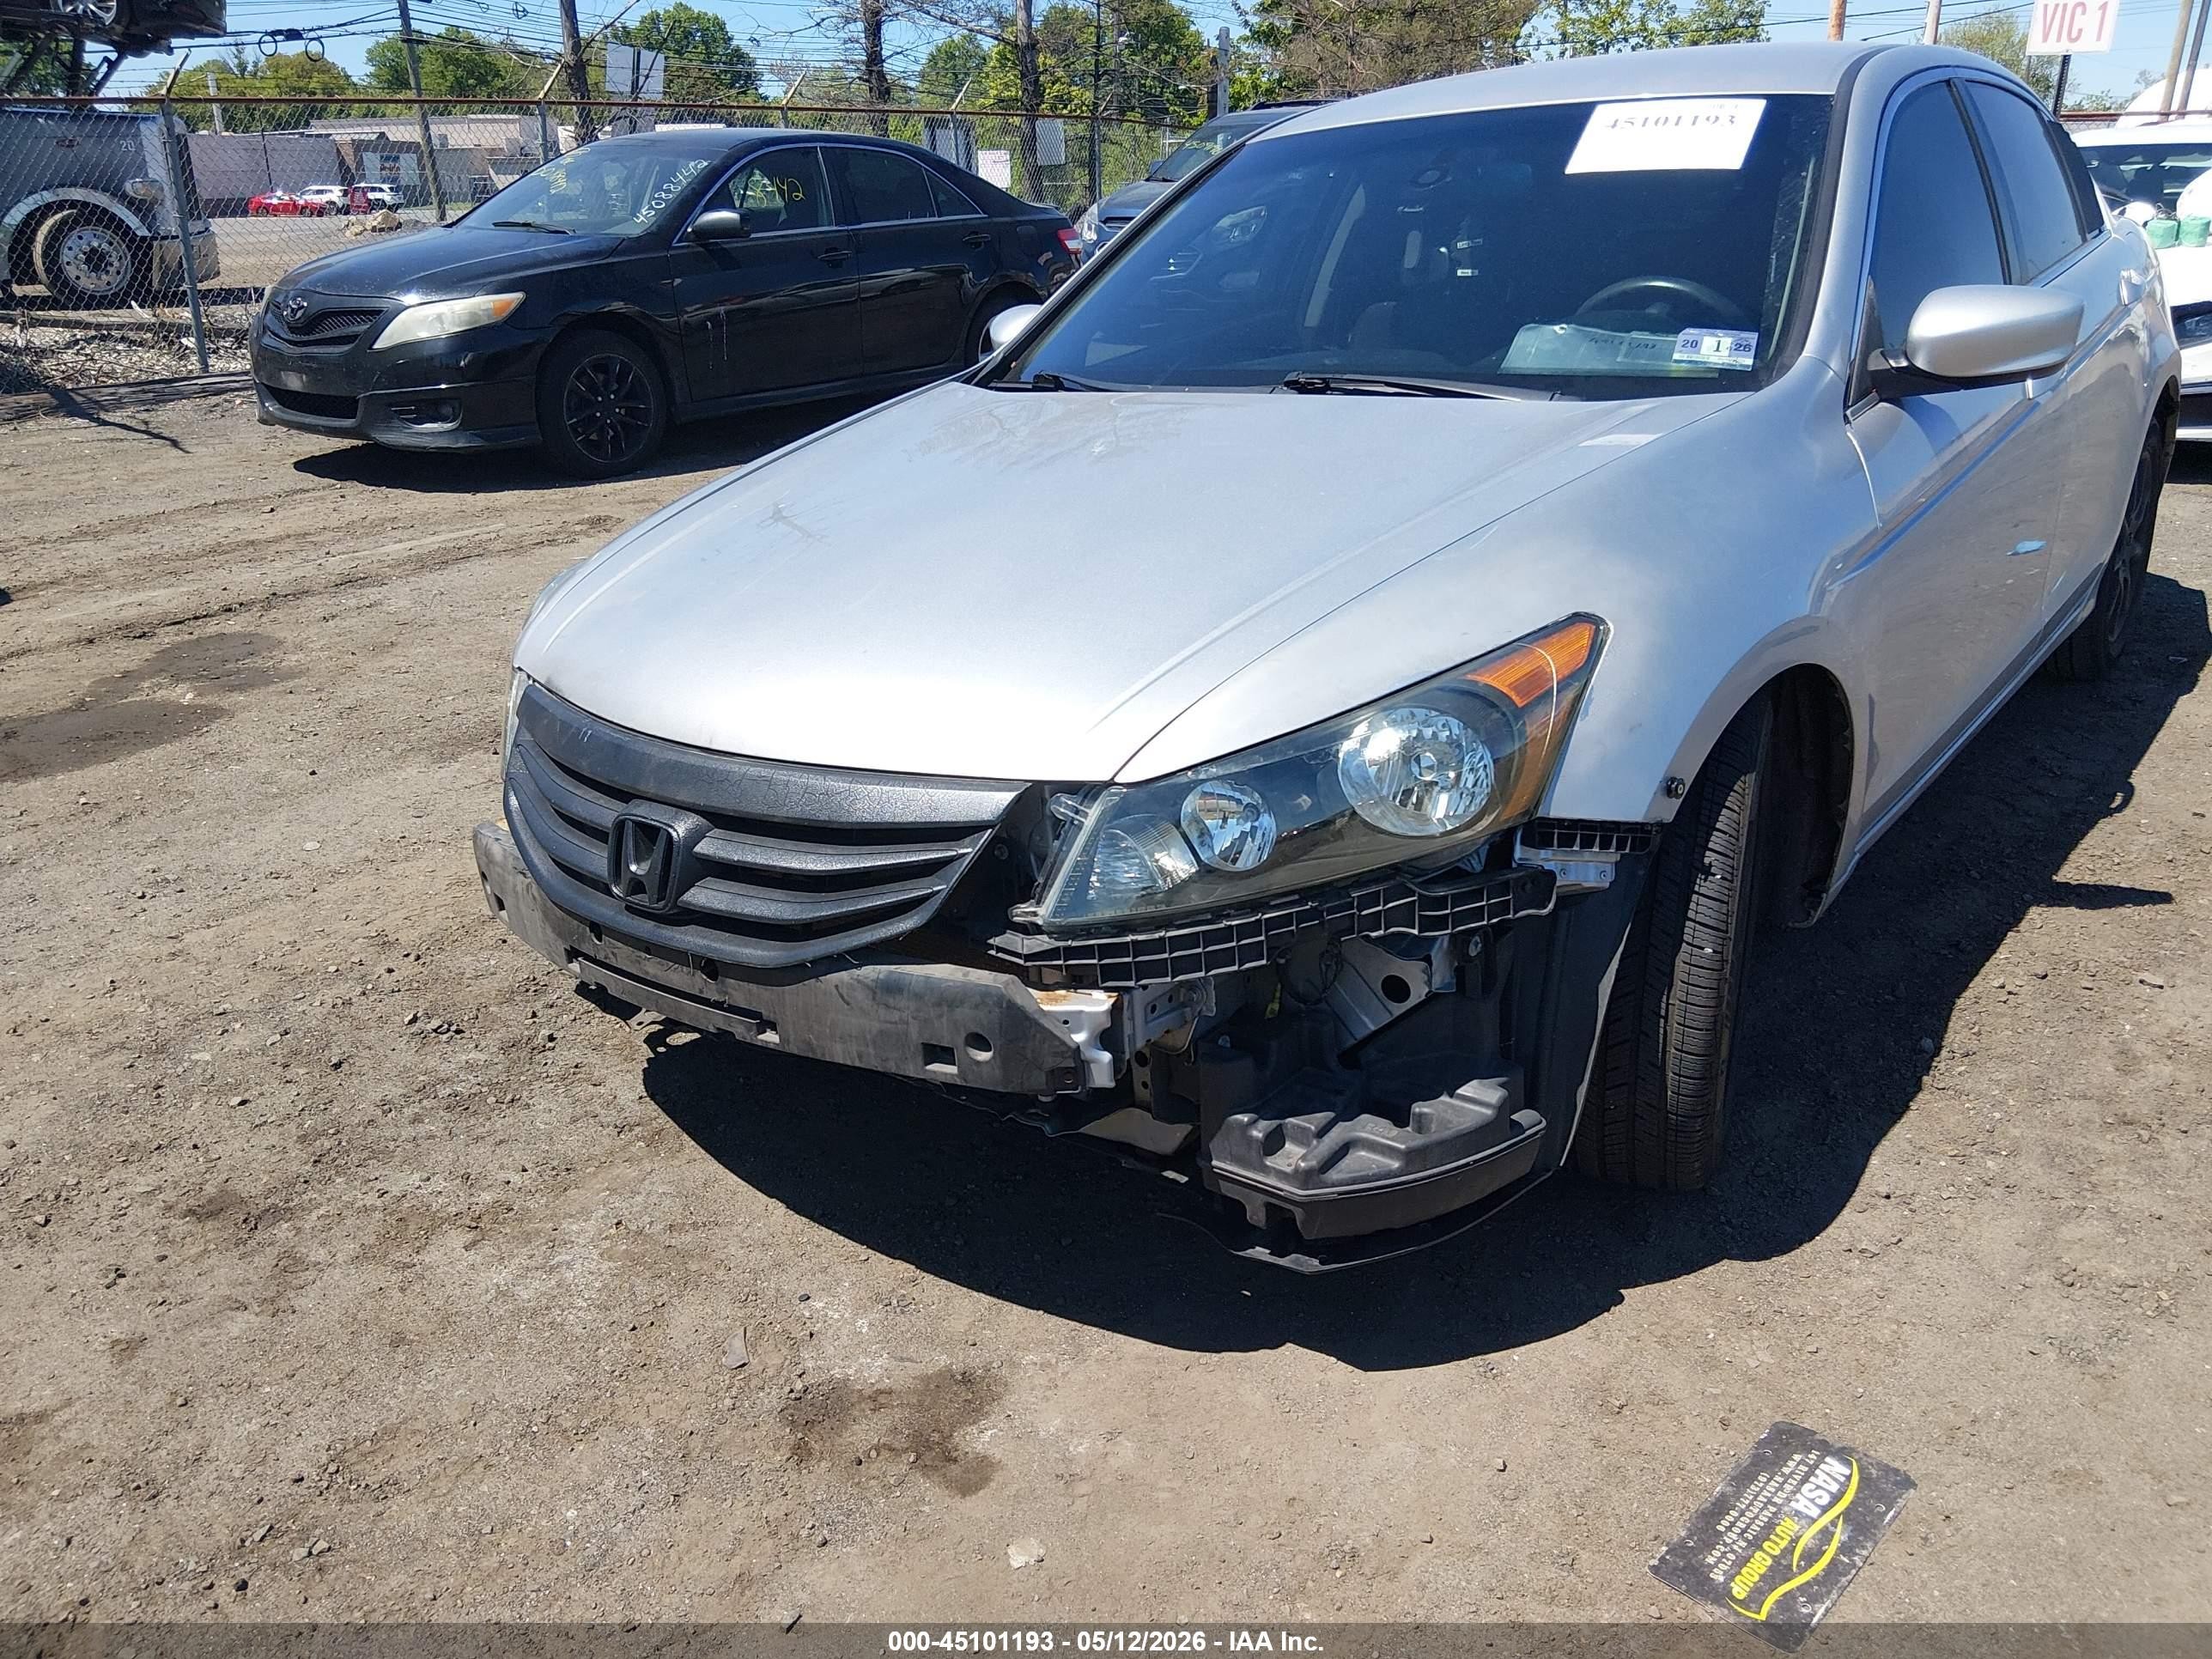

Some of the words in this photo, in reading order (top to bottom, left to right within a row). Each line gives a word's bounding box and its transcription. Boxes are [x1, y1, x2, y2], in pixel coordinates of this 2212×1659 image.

[2042, 2, 2087, 43] VIC
[2095, 1, 2109, 41] 1
[633, 159, 712, 224] 45088442
[1681, 339, 1698, 349] 20
[1713, 339, 1722, 352] 1
[1733, 343, 1753, 353] 26
[1805, 1449, 1820, 1465] 147
[1789, 1456, 1851, 1518] NASA
[1744, 1504, 1778, 1540] PASSAIC
[1762, 1516, 1800, 1555] AUTO
[1730, 1551, 1772, 1600] GROUP
